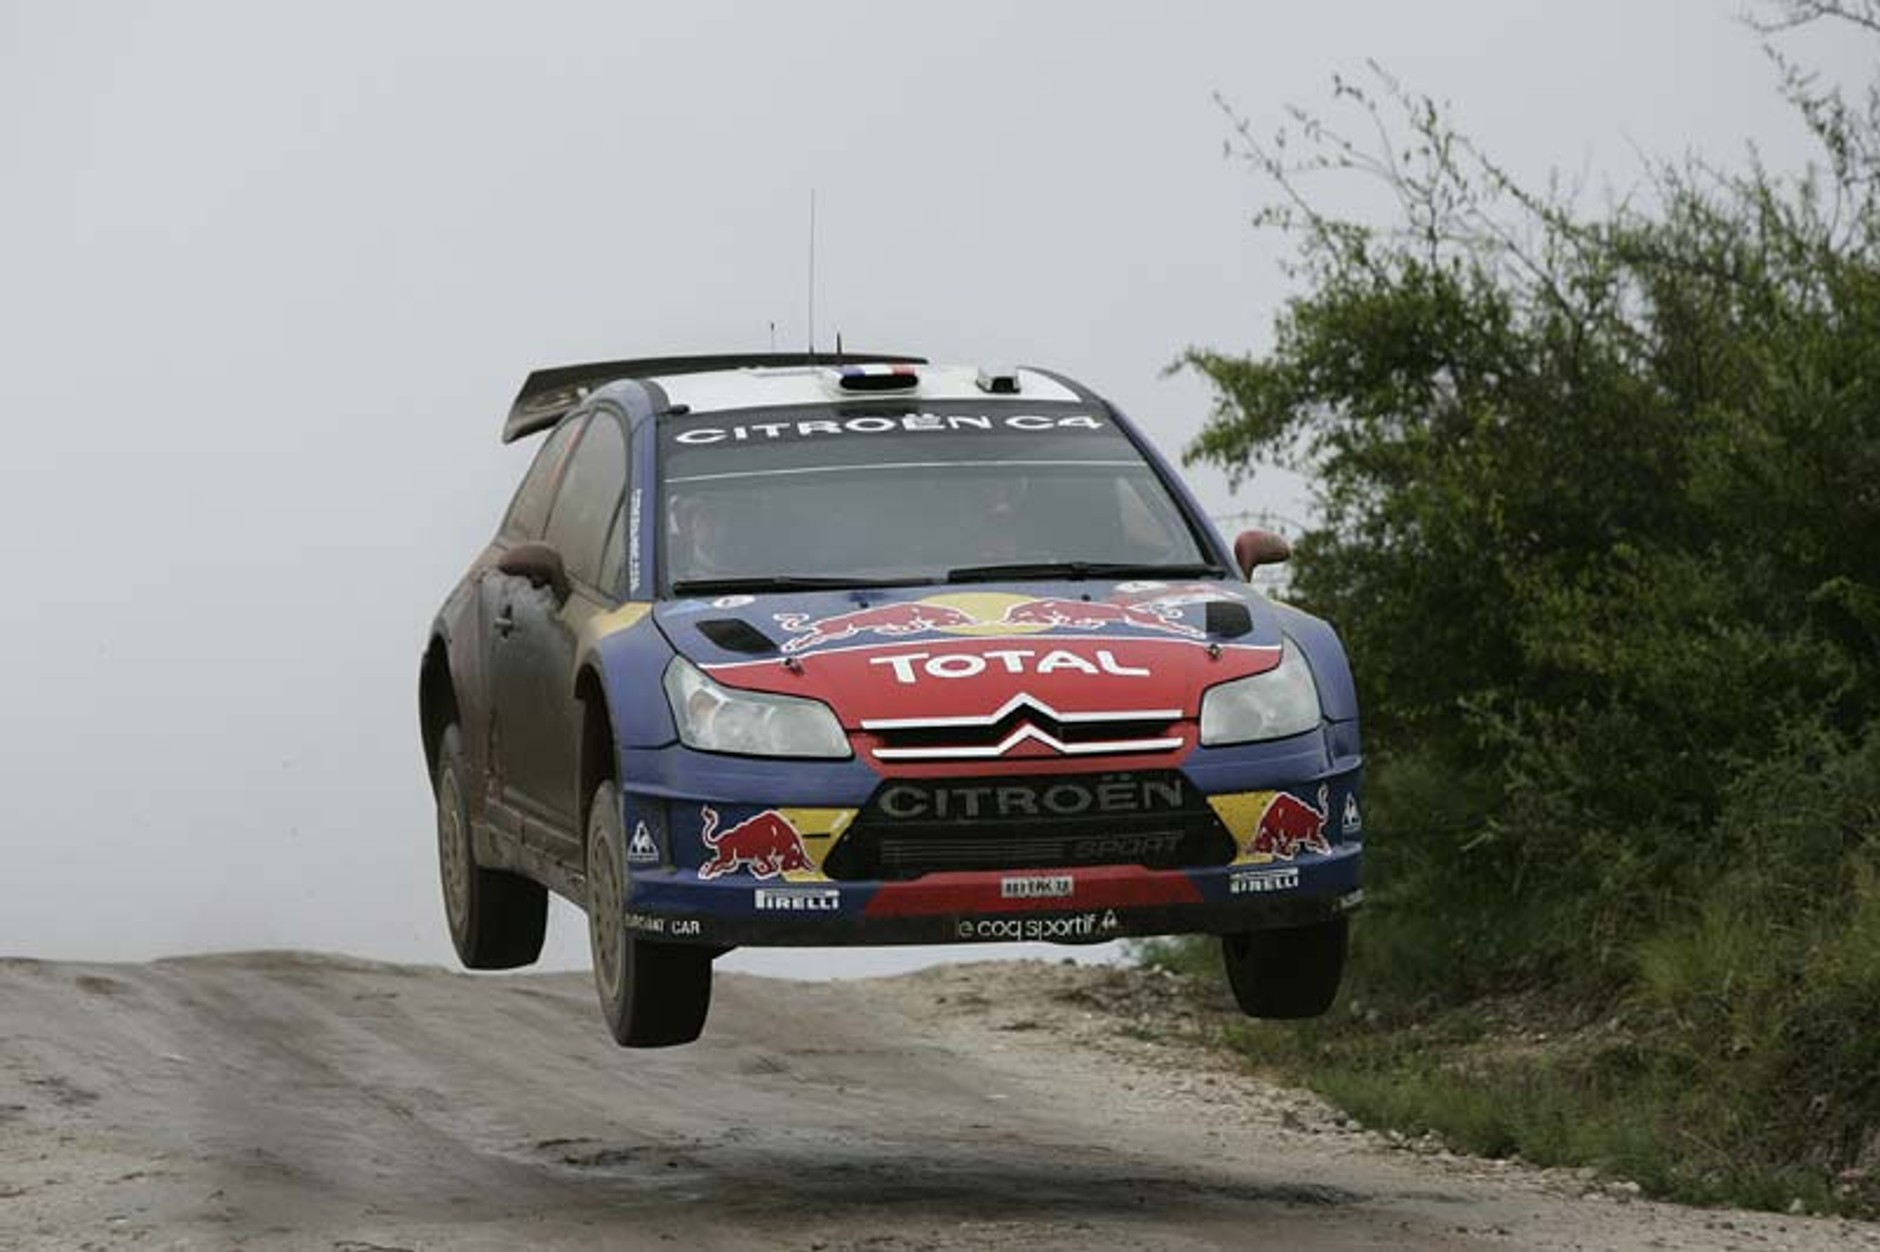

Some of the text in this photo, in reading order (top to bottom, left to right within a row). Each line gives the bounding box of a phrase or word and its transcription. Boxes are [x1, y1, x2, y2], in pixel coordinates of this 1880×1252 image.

[675, 413, 1104, 444] CITROËN C4
[869, 649, 1151, 684] TOTAL
[878, 773, 1185, 818] CITROËN
[754, 888, 840, 911] PIRELLI
[671, 919, 700, 935] CAR
[977, 919, 1022, 942] coq
[1025, 913, 1097, 941] sportif
